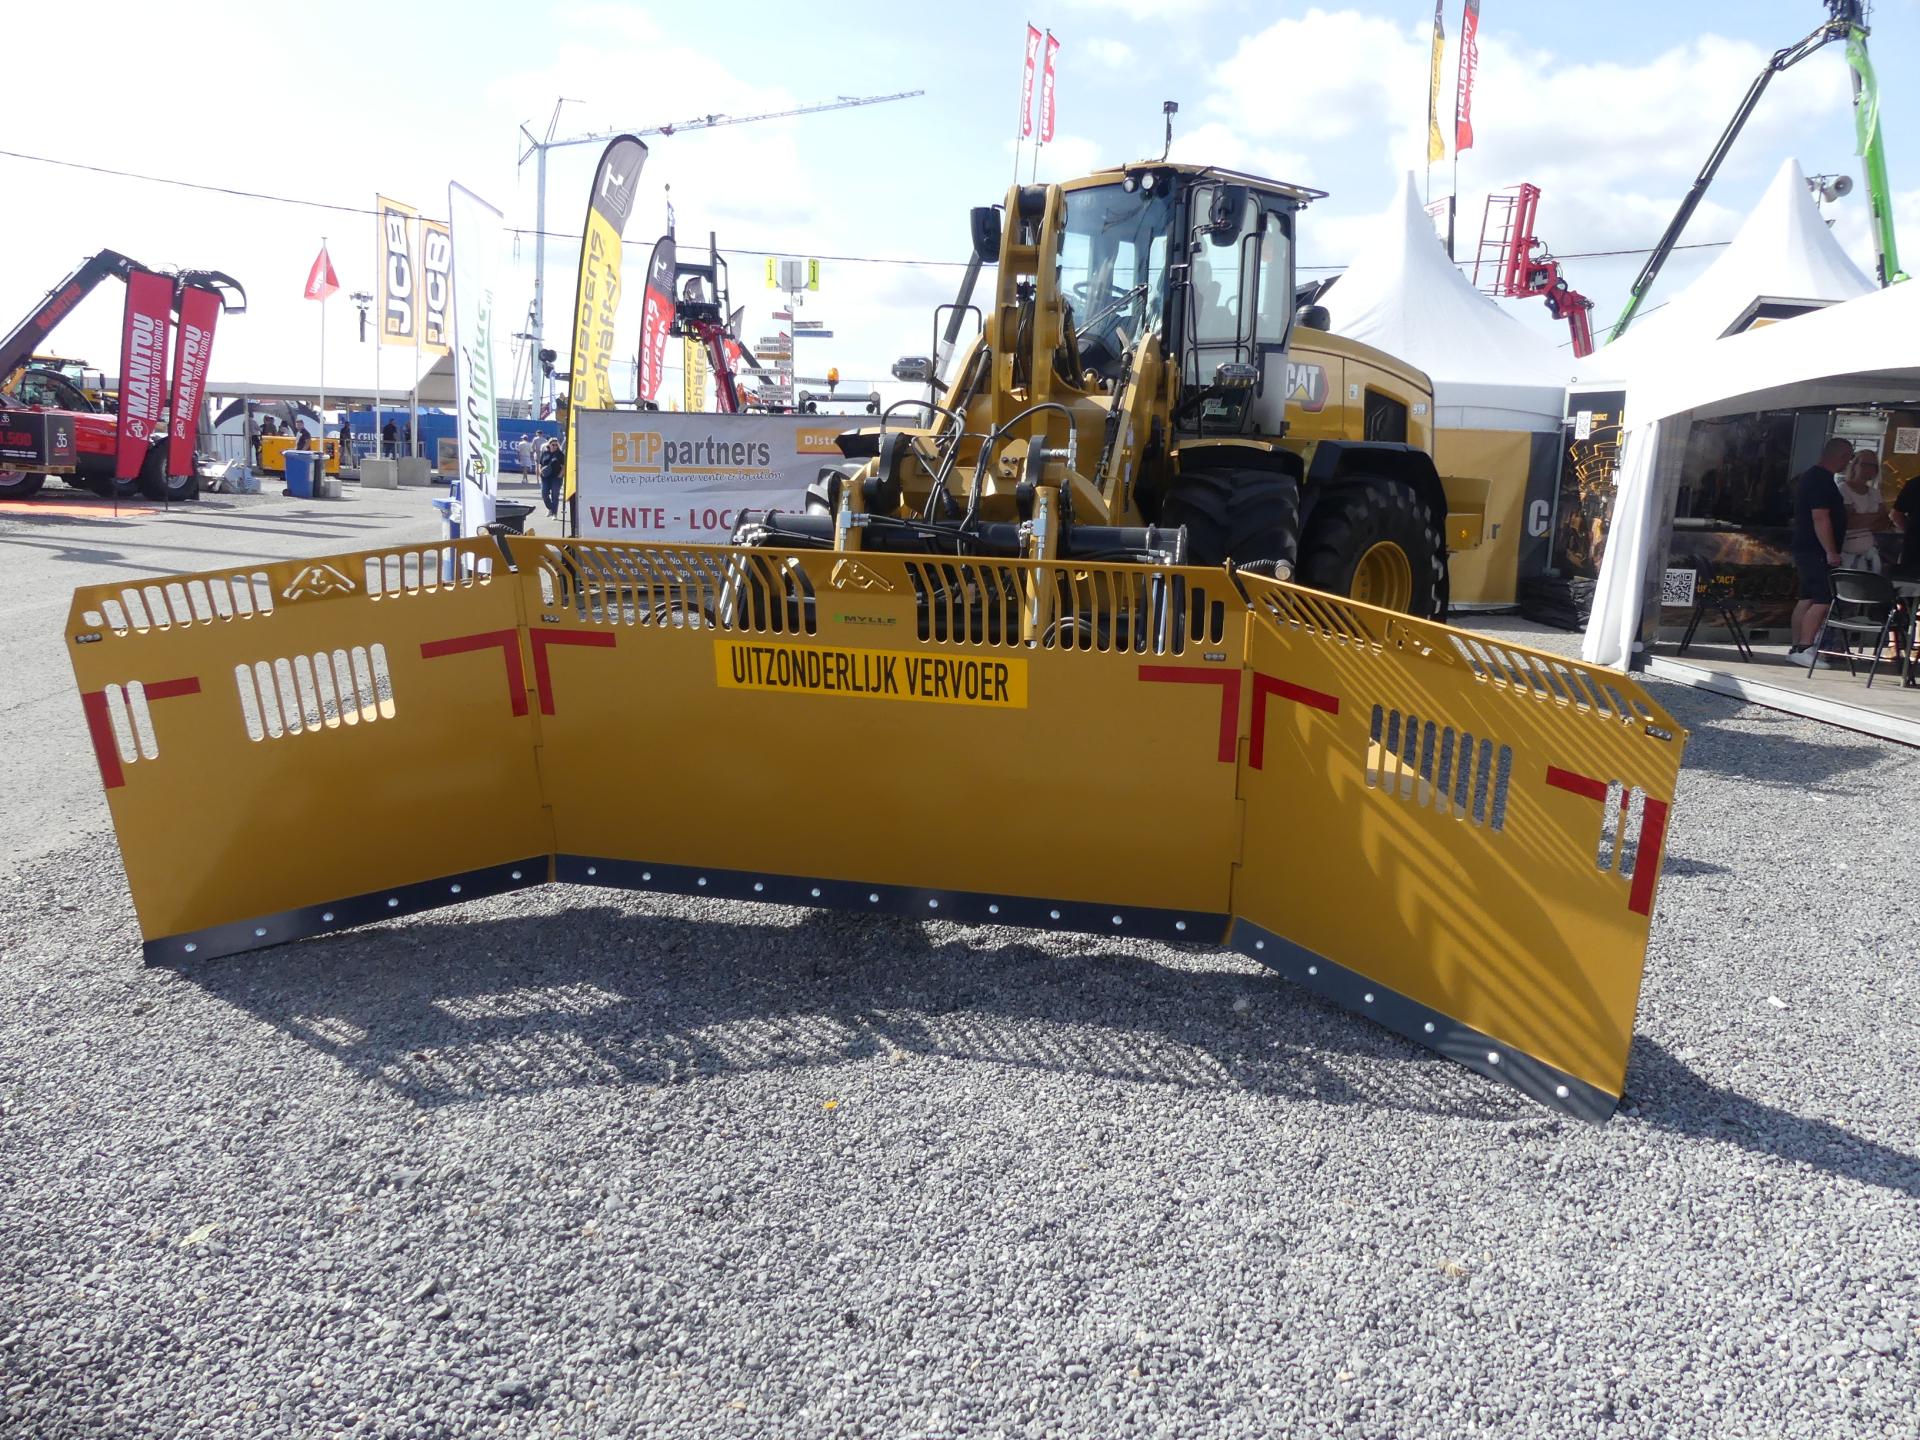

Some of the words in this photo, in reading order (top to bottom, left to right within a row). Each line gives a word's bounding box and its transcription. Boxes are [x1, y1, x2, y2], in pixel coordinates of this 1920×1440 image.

[386, 211, 412, 335] JCB
[425, 230, 450, 344] JCB
[153, 319, 164, 349] WORLD
[573, 228, 605, 409] EUSDENS
[151, 349, 162, 376] YOUR
[197, 331, 210, 358] WORLD
[128, 313, 154, 419] MANITOU
[177, 324, 202, 419] MANITOU
[193, 355, 205, 382] YOUR
[1285, 362, 1320, 400] CAT
[149, 377, 161, 421] HANDLING
[186, 381, 199, 422] HANDLING
[56, 433, 68, 448] 35
[609, 473, 637, 485] Votre
[639, 474, 695, 486] partenaire
[698, 472, 725, 482] vente
[738, 471, 784, 482] location
[590, 506, 665, 529] VENTE
[844, 615, 897, 625] MYLLE
[731, 645, 899, 694] UITZONDERLIJK
[904, 656, 1009, 702] VERVOER
